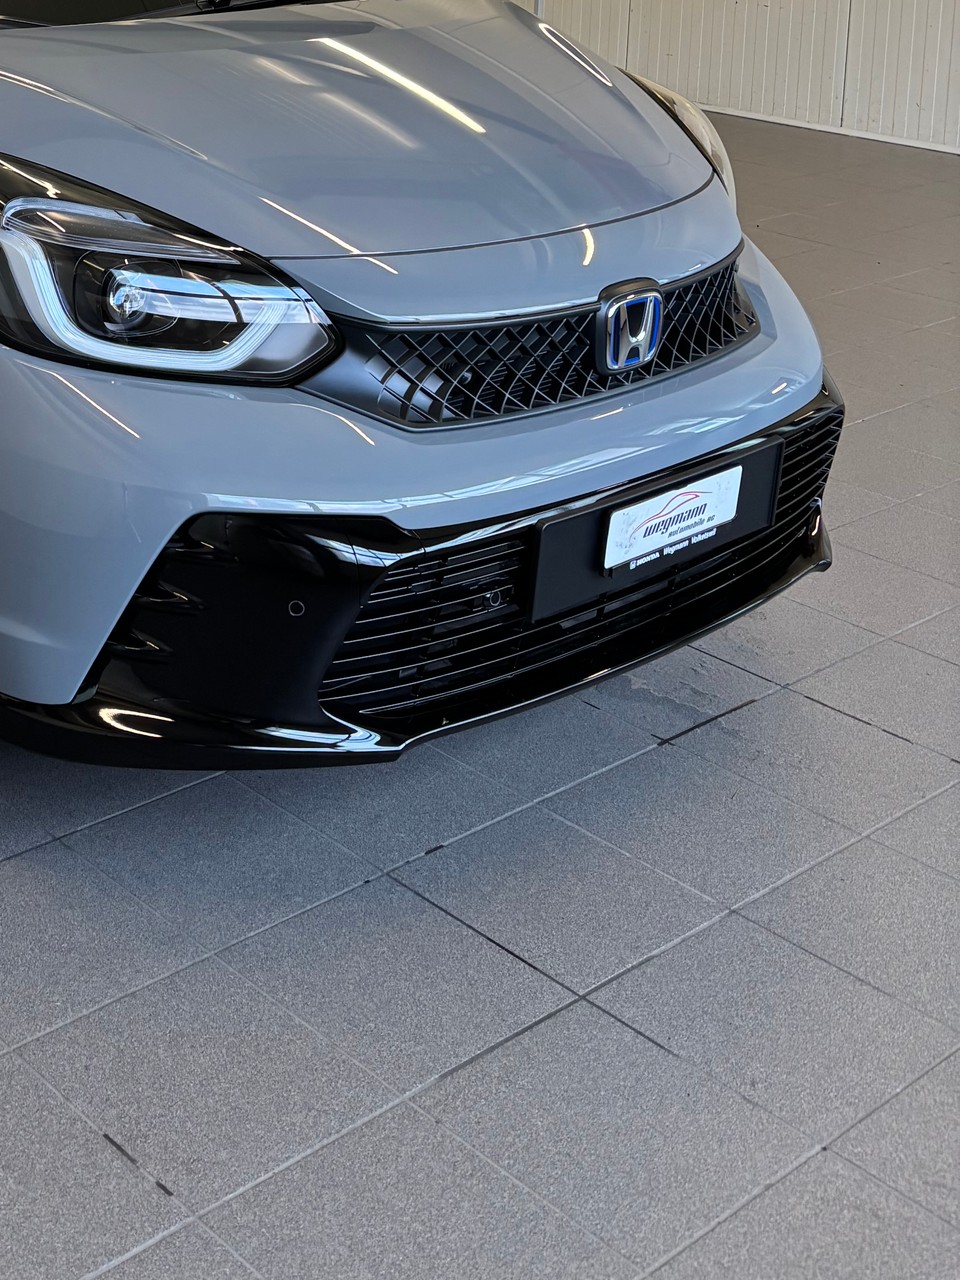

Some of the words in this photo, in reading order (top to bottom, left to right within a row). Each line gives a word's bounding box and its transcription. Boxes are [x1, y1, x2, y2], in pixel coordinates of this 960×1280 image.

[643, 503, 708, 538] wegmann
[636, 552, 660, 566] HONDA
[663, 540, 689, 556] Wegmann
